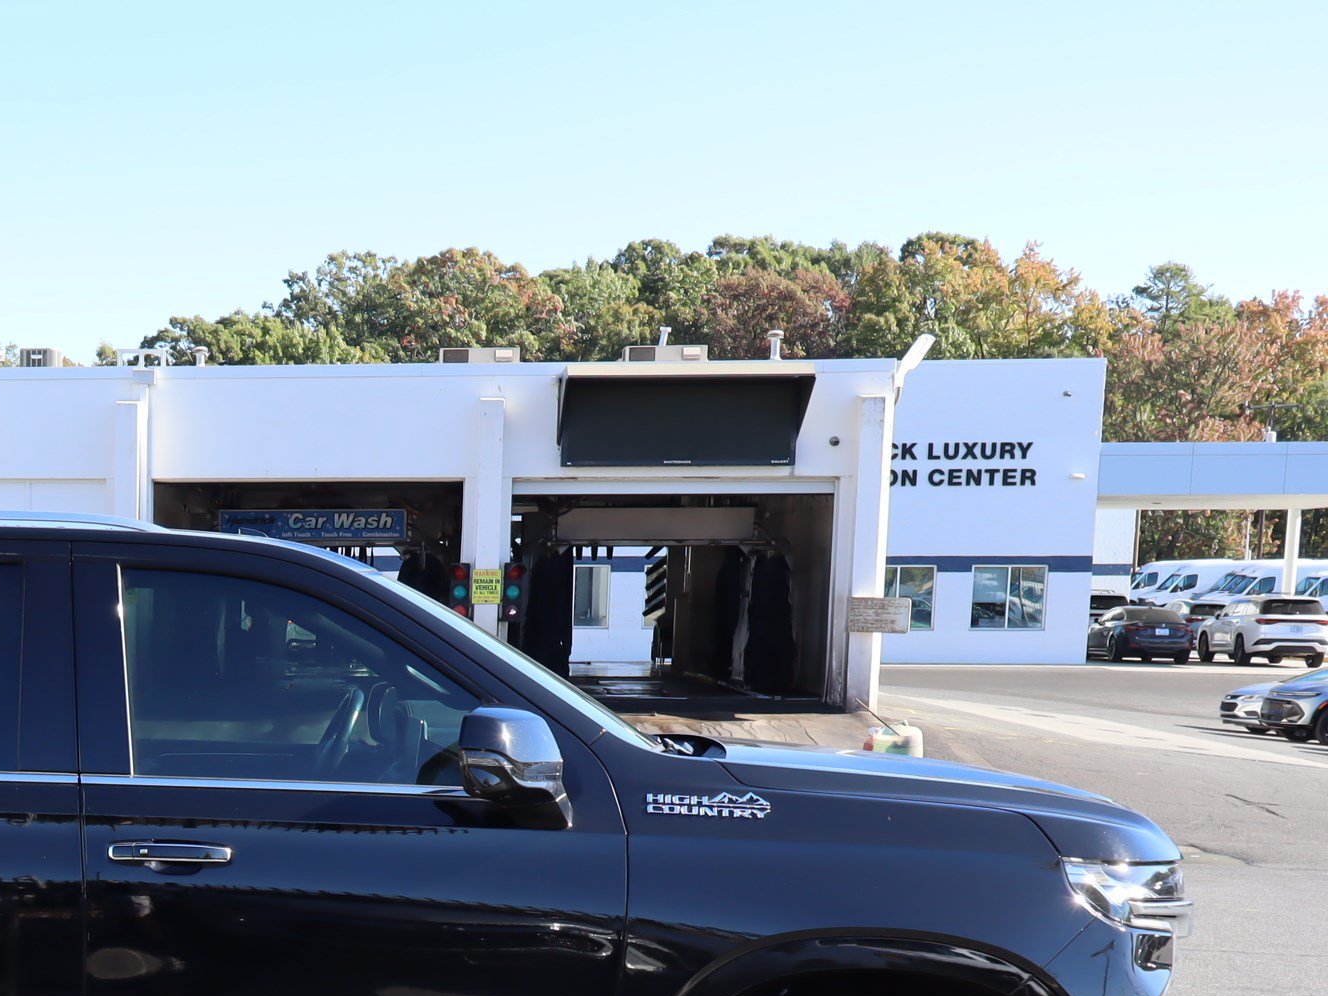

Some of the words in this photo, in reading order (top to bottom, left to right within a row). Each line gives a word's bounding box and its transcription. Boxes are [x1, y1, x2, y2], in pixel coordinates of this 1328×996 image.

[927, 442, 1034, 460] LUXURY
[927, 468, 1037, 487] CENTER
[288, 513, 327, 529] Car
[333, 512, 393, 529] Wash
[646, 793, 709, 805] HIGH
[646, 803, 771, 819] COUNTRY
